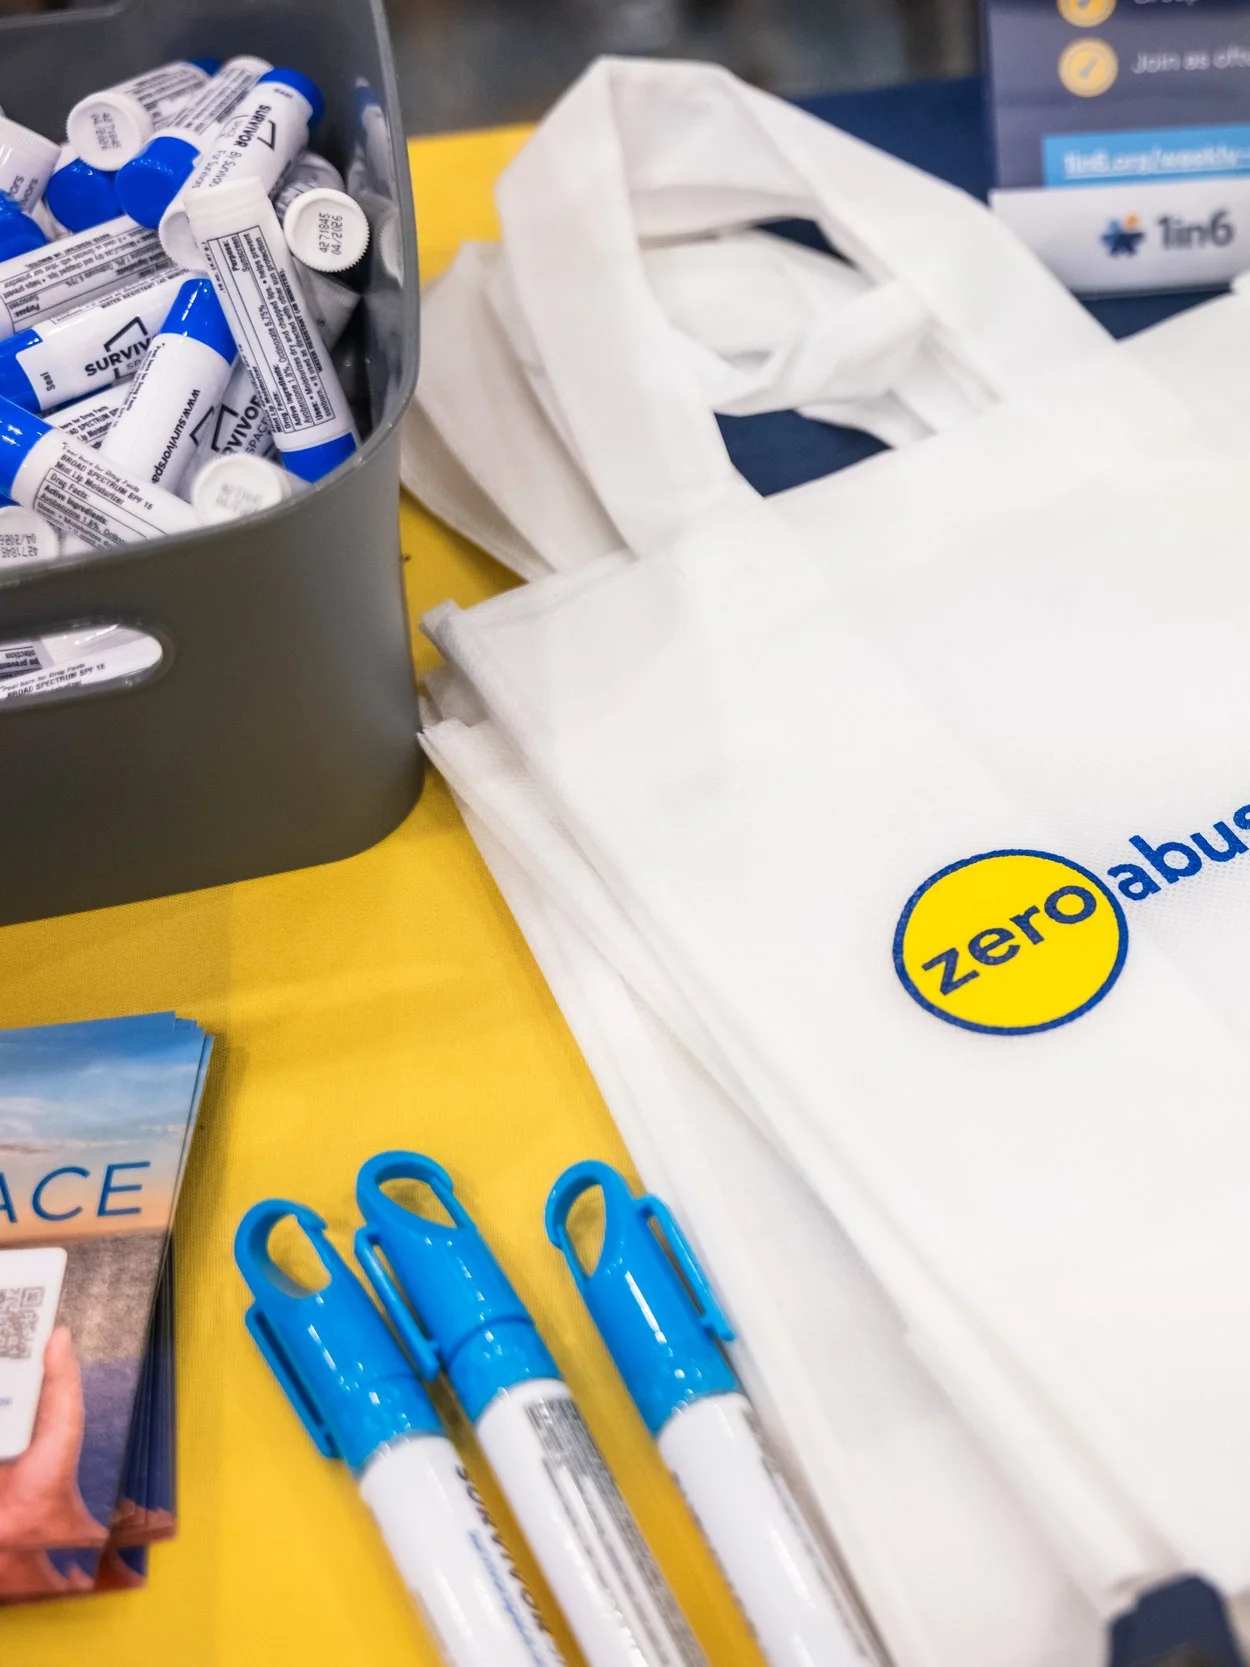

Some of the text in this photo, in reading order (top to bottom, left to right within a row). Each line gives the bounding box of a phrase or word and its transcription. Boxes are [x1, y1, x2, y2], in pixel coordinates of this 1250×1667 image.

[1132, 49, 1180, 74] Join
[234, 104, 271, 147] SURVIVOR
[318, 212, 331, 254] 4271845
[330, 215, 343, 256] 04/2026
[1156, 208, 1235, 250] 1in6
[231, 235, 251, 272] Sunscreen
[242, 232, 323, 420] Uses: Moisturizes dry and chapped lips. helps prevent
[255, 236, 333, 417] sunburn. used as directed with other sun protection
[267, 327, 287, 363] Octinoxate
[296, 314, 314, 349] RESISTANT
[310, 349, 323, 372] WATER
[40, 371, 56, 392] Seal
[252, 365, 276, 416] Lip Moisturizer
[273, 363, 302, 426] Active Ingredients:
[272, 390, 293, 429] Drug Facts:
[291, 384, 313, 423] Avobenzone
[151, 389, 199, 483] www.survivorspa
[49, 473, 89, 500] Drug Facts:
[60, 453, 87, 472] BROAD
[86, 469, 127, 495] SPECTRUM
[71, 470, 124, 504] Lip Moisturizer
[43, 484, 107, 525] Active Ingredients:
[35, 672, 77, 690] SPECTRUM
[79, 666, 93, 676] SPF
[48, 663, 85, 678] Drug Facts
[921, 884, 1097, 996] zero
